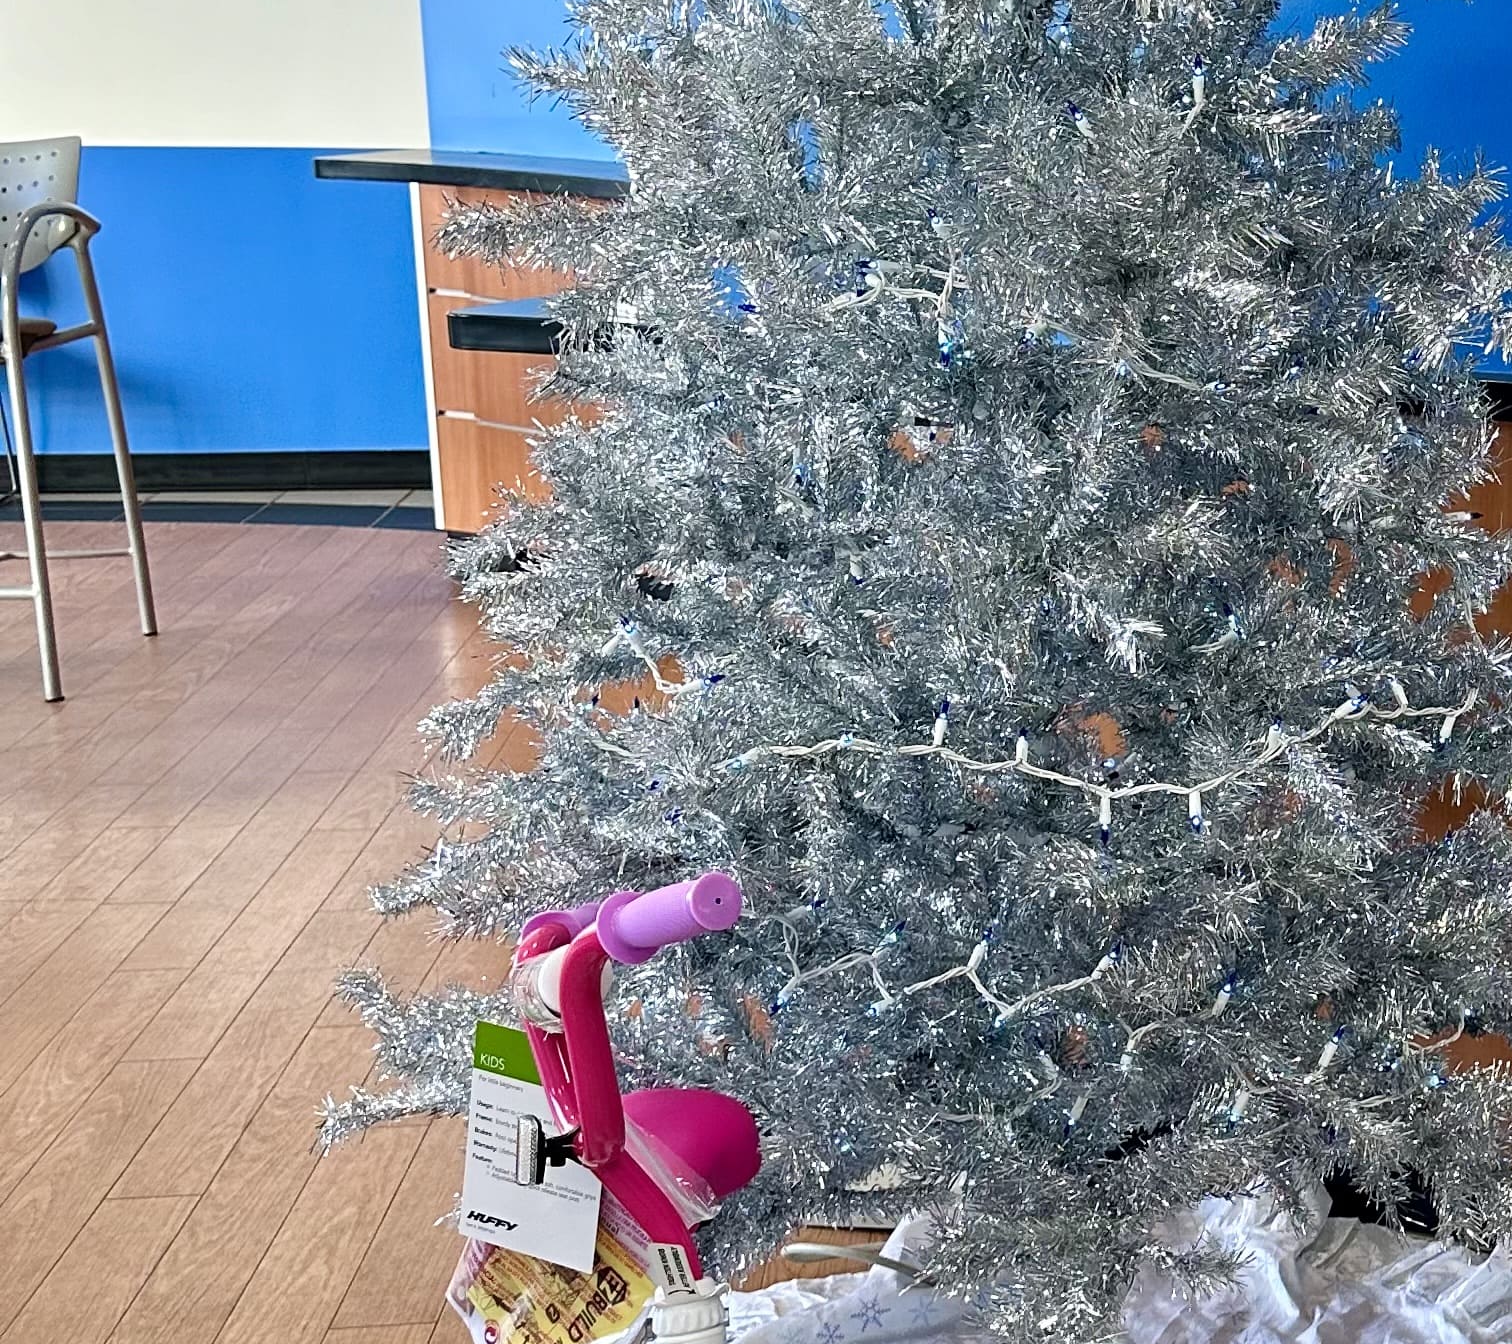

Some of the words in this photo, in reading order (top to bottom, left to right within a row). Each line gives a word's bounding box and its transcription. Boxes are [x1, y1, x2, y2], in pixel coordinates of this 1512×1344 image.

[480, 1053, 505, 1071] KIDS
[467, 1210, 519, 1231] HUFFY
[568, 1293, 610, 1343] BUILD
